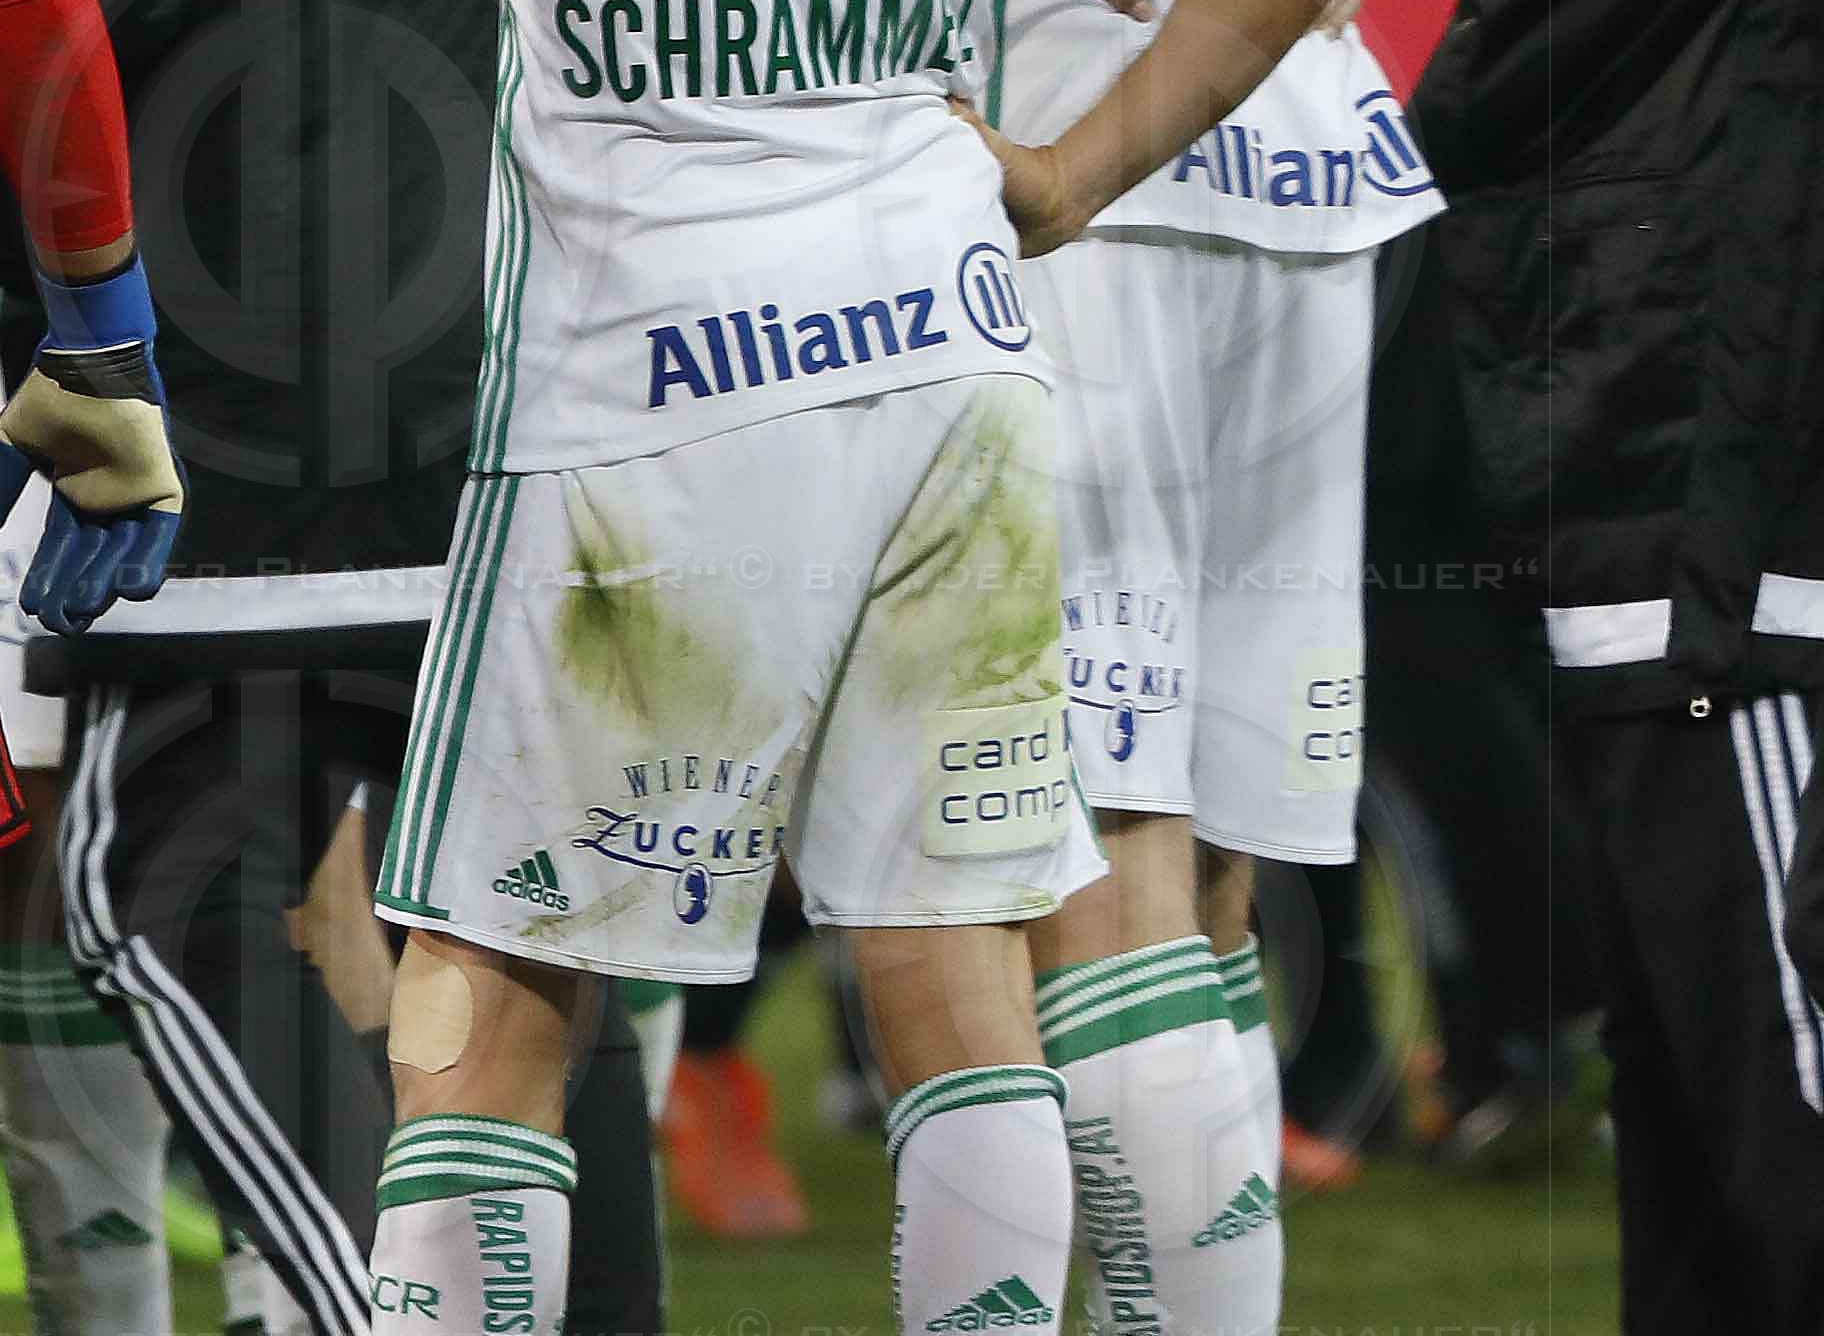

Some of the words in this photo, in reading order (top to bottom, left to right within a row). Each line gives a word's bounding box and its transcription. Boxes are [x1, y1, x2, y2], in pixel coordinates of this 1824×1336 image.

[1171, 123, 1355, 208] Allian
[645, 284, 949, 409] Allianz
[939, 732, 1050, 774] card
[939, 781, 1067, 827] comp
[491, 877, 572, 913] adidas
[372, 1273, 442, 1321] CR
